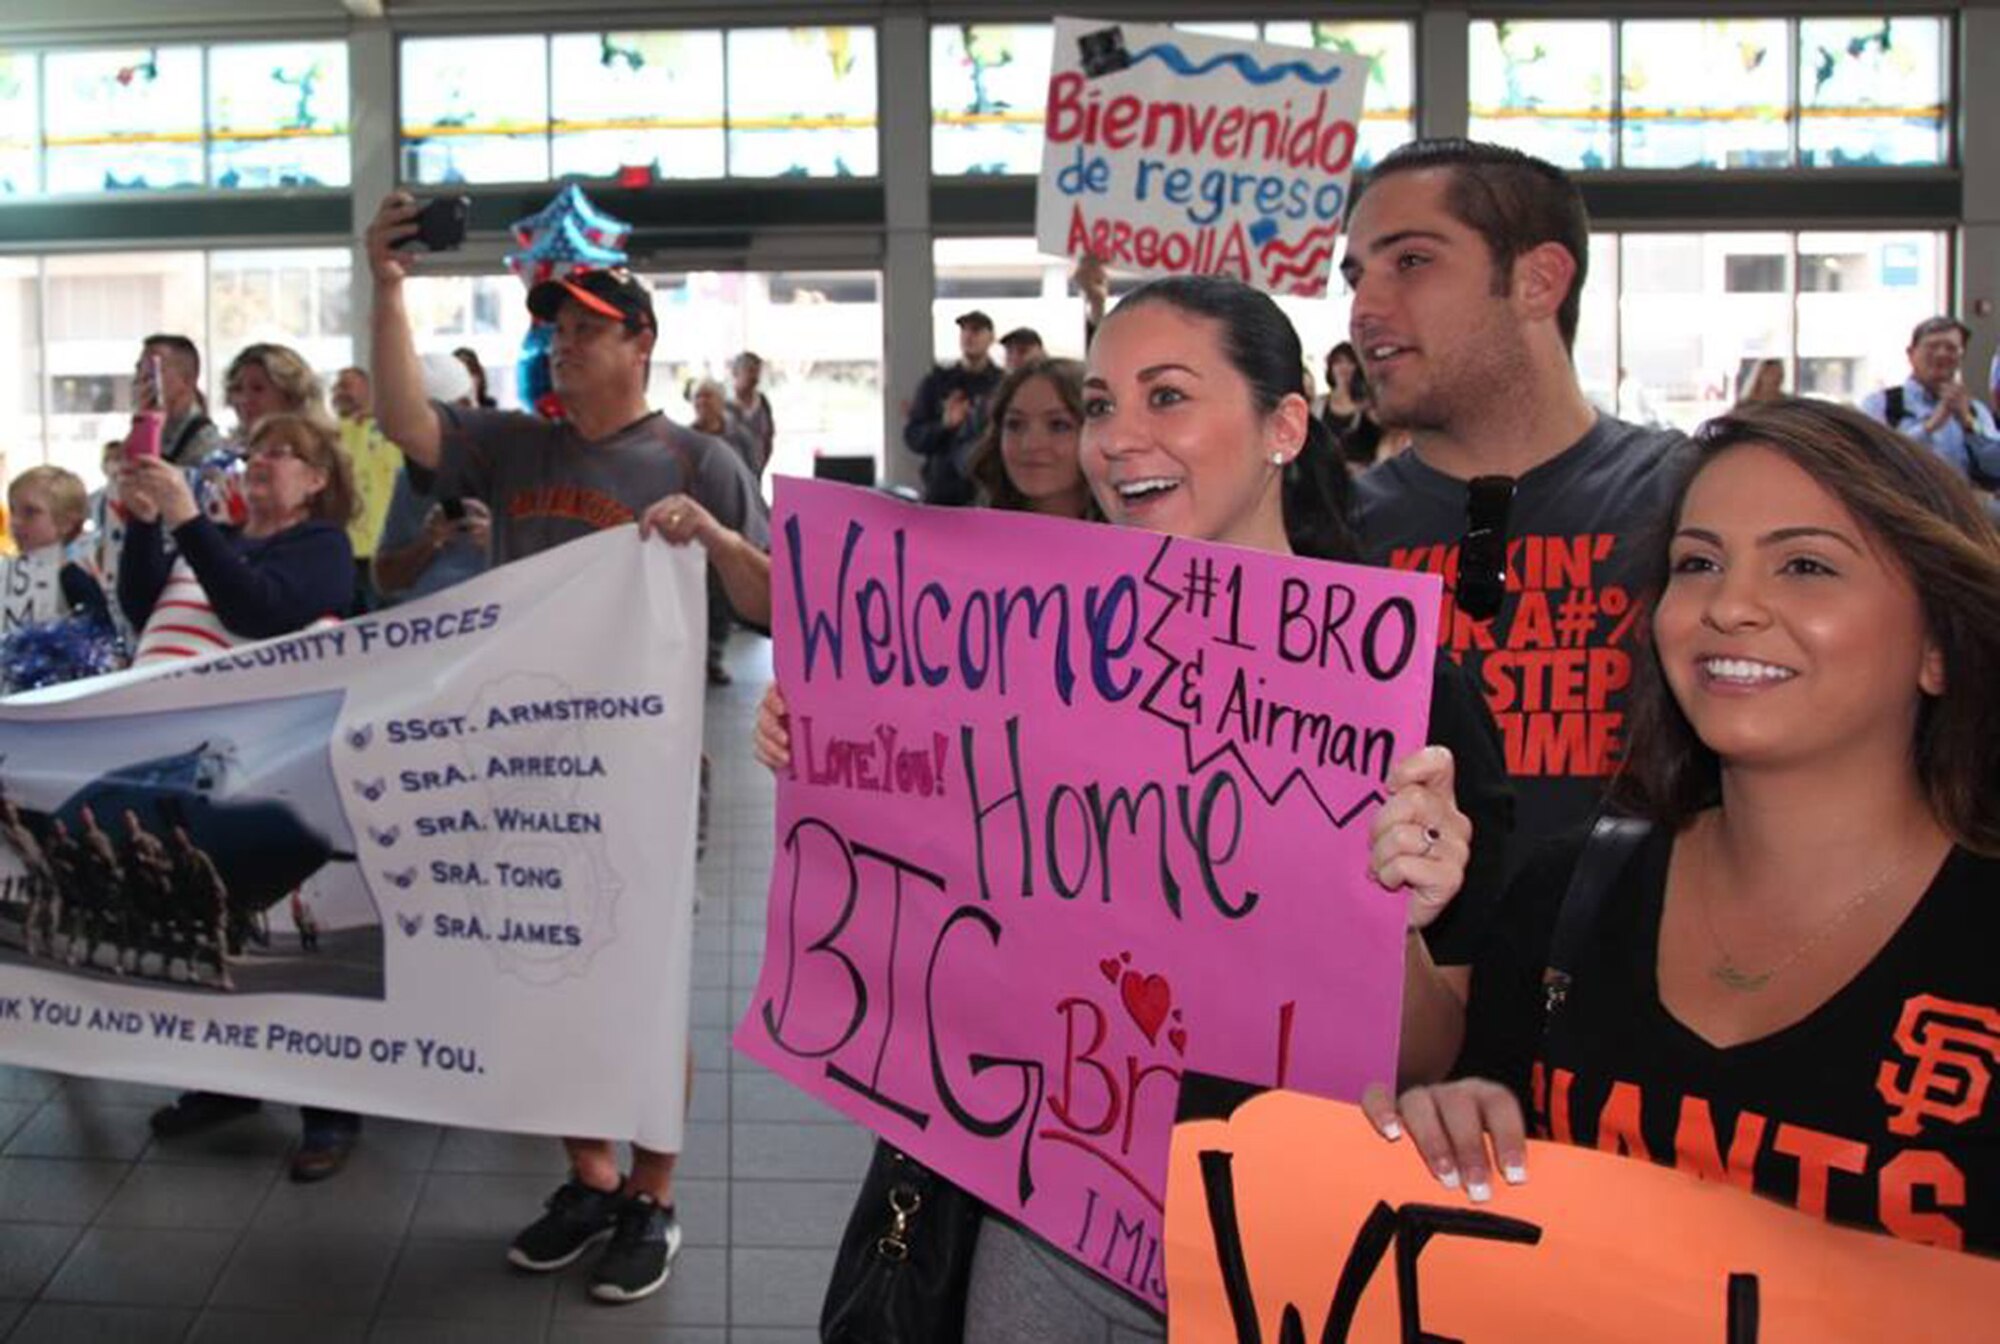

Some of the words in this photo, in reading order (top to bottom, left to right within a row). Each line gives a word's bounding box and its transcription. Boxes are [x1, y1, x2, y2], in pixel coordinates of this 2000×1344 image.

[1046, 70, 1357, 174] Bienvenido
[1056, 147, 1110, 196] de
[1135, 157, 1343, 225] regreso
[358, 604, 500, 653] FORCES
[785, 514, 1144, 704] Welcome
[1183, 557, 1257, 651] #1
[1278, 577, 1417, 681] BRO
[1180, 648, 1203, 725] &
[1216, 667, 1395, 783] Airman
[1481, 648, 1632, 712] STEP
[961, 716, 1258, 920] Home
[762, 816, 1044, 1208] BIG
[1072, 1187, 1099, 1253] I
